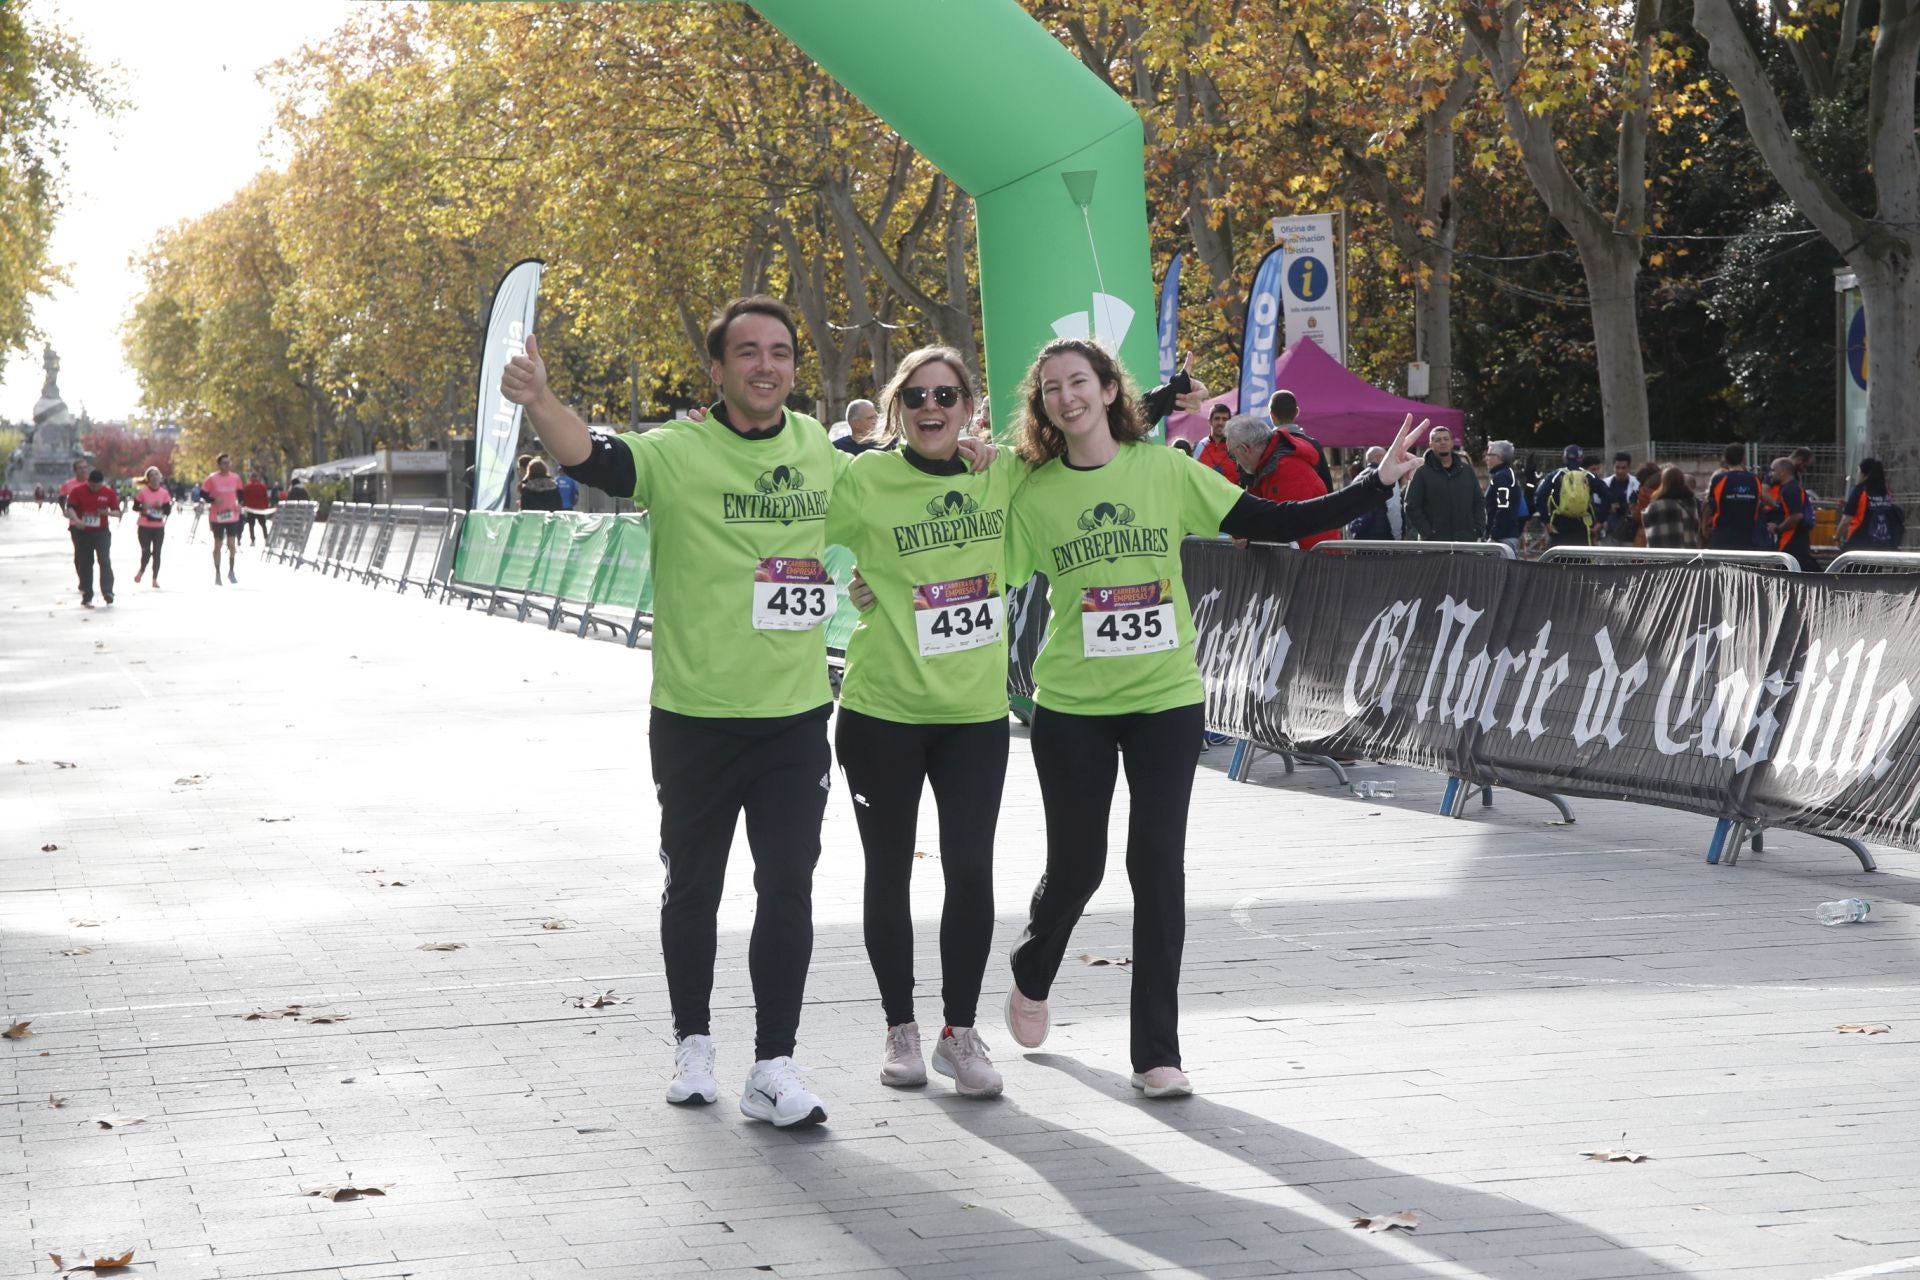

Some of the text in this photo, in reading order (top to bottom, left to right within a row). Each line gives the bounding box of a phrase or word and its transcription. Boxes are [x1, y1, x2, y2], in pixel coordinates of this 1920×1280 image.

[1250, 292, 1277, 418] IVECO
[1052, 527, 1169, 572] ENTREPINARES
[786, 567, 817, 576] EMPRESAS
[944, 581, 969, 590] CARRERA
[767, 586, 826, 616] 433
[945, 585, 976, 598] EMPRESAS
[1113, 586, 1140, 595] CARRERA
[1141, 585, 1148, 593] DE
[1113, 592, 1148, 602] EMPRESAS
[930, 602, 994, 638] 434
[1096, 609, 1162, 641] 435
[1343, 594, 1914, 783] El Norte de Castilla
